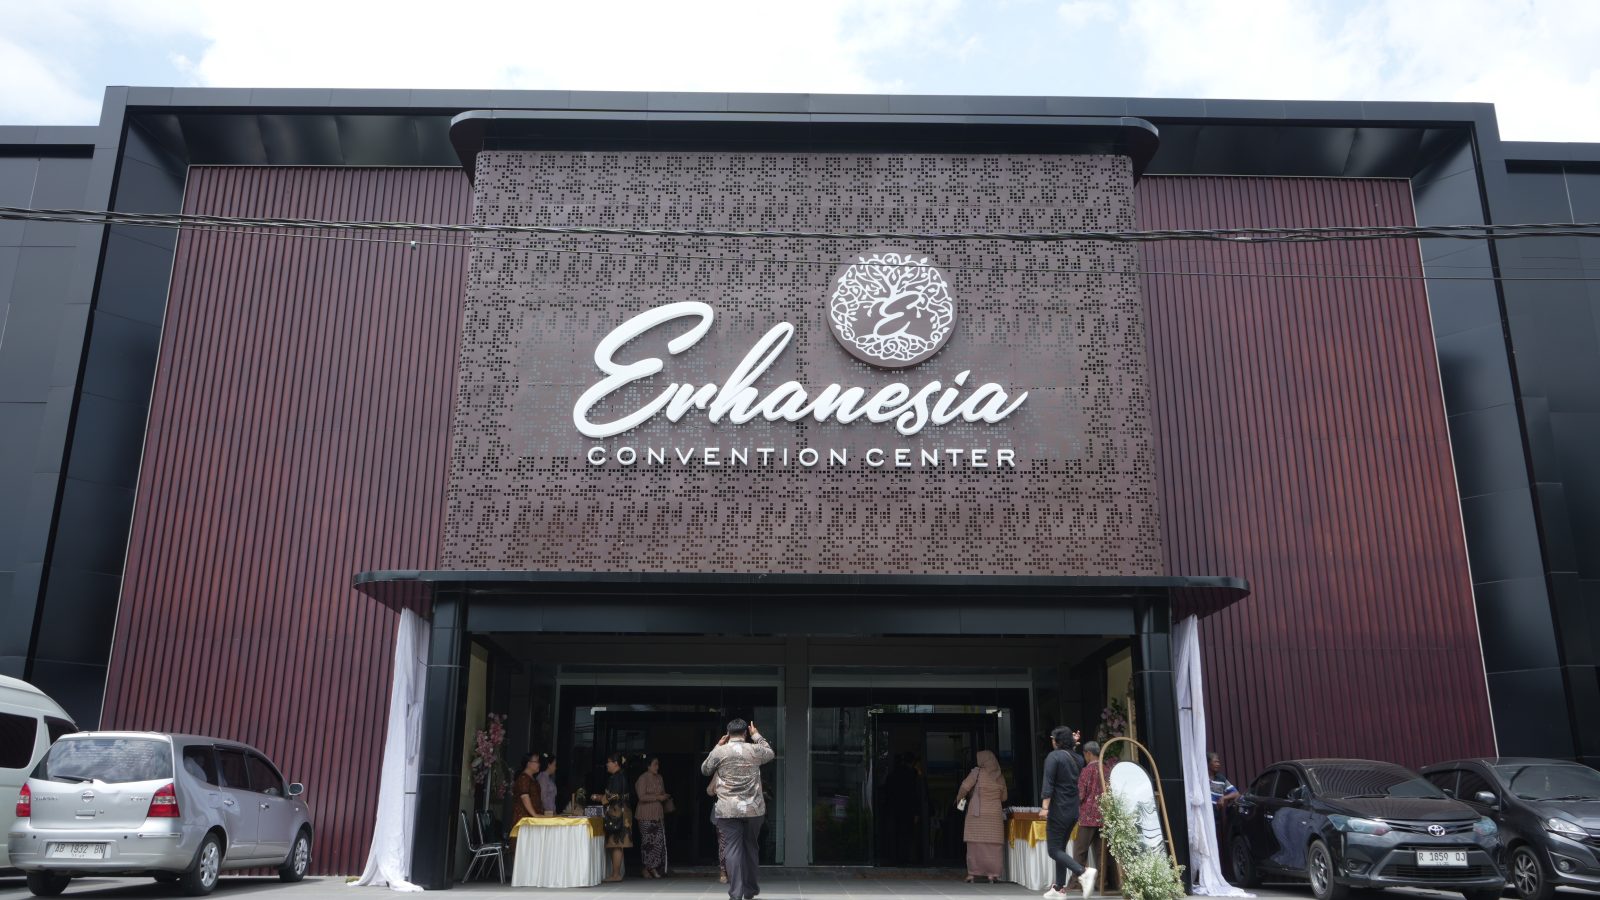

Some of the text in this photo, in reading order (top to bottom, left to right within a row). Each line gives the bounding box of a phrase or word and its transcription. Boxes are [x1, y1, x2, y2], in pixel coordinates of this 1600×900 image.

[573, 301, 1029, 438] Erhanesia
[587, 446, 1017, 469] CONVENTION CENTER
[54, 843, 66, 853] AB
[70, 843, 89, 854] 1932
[1418, 852, 1424, 861] R
[1429, 852, 1449, 861] 1859
